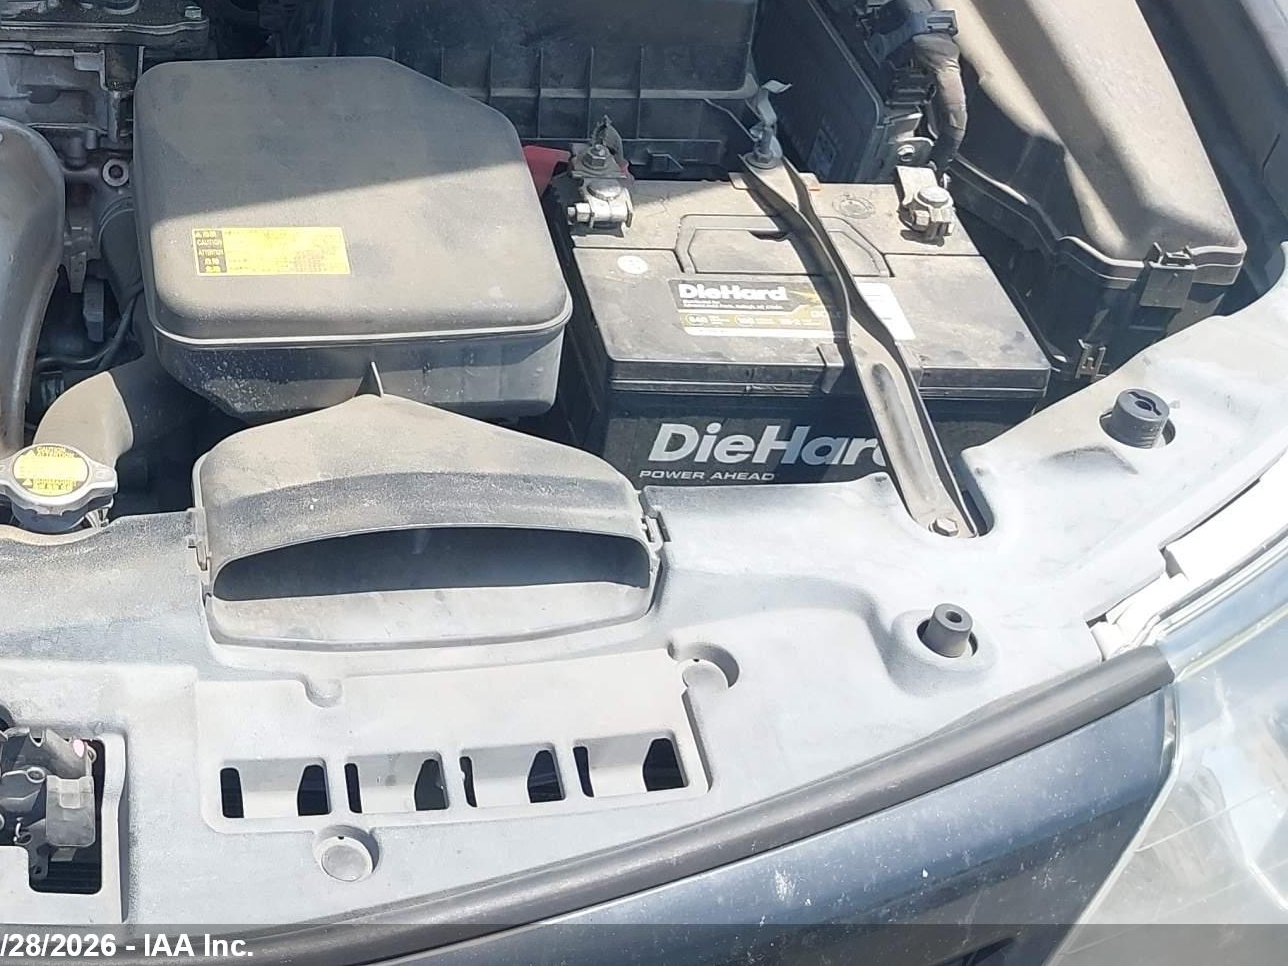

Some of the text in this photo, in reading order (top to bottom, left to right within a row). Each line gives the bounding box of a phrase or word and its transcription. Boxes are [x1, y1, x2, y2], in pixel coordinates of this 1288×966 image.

[677, 282, 788, 301] DieHard
[639, 470, 775, 481] POWER AHEAD
